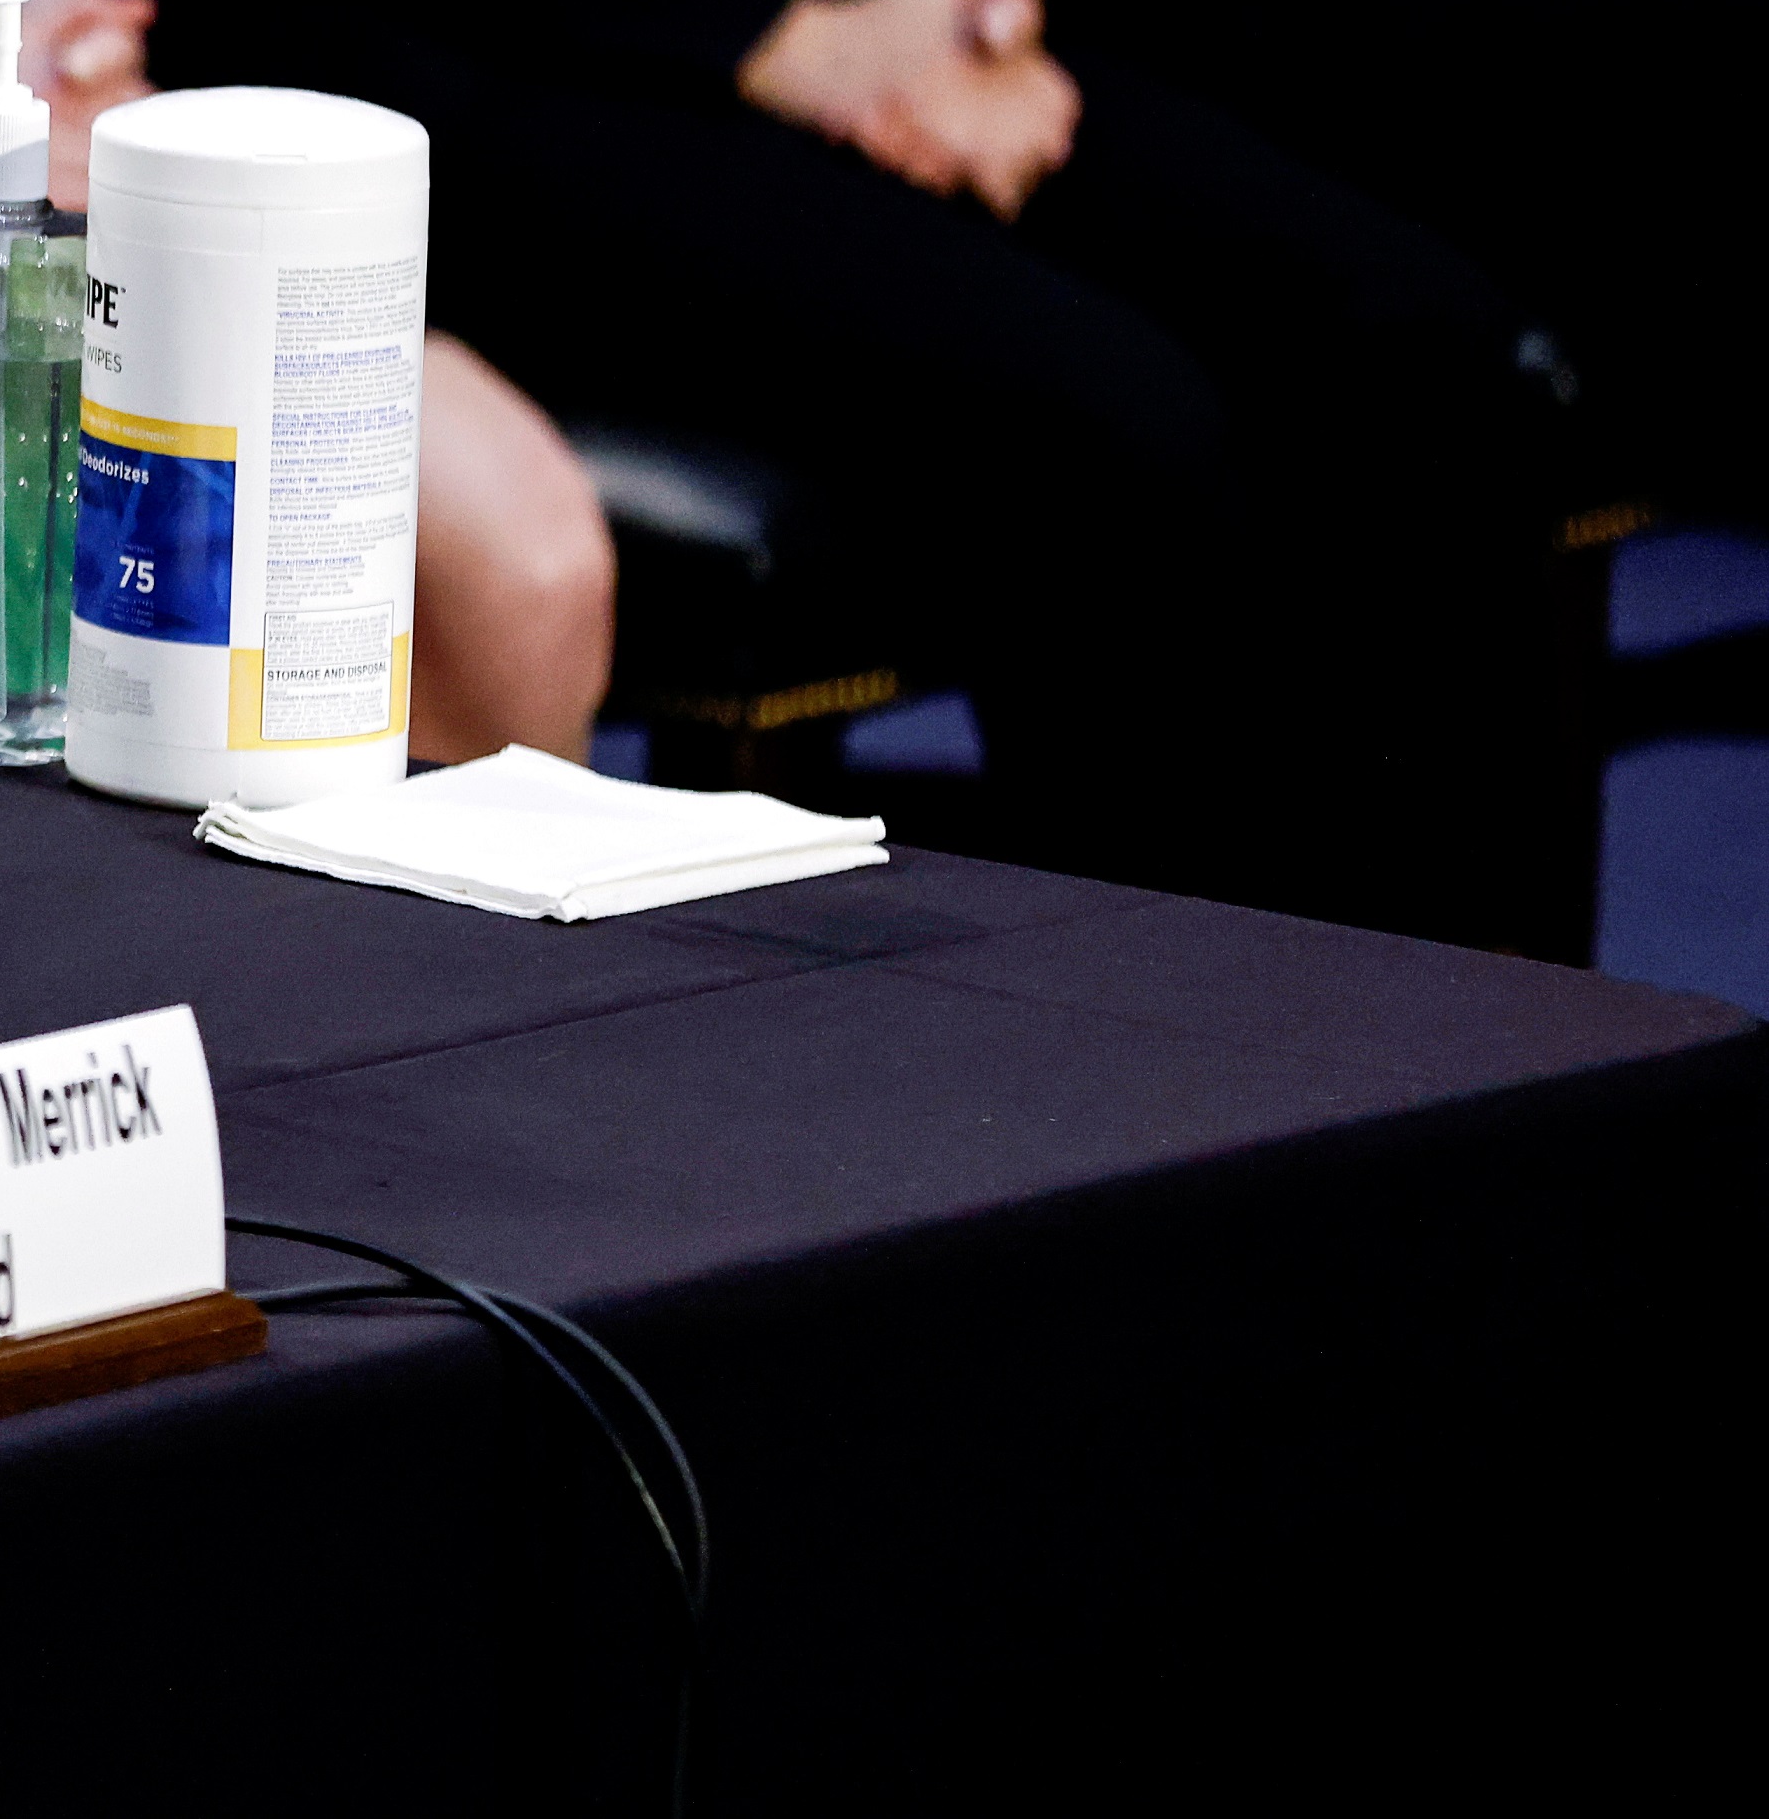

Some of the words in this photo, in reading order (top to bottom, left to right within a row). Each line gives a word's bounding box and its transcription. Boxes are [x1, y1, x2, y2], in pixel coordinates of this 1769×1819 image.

[85, 344, 122, 373] WIPES
[82, 449, 150, 485] Deodorizes
[119, 555, 155, 594] 75
[267, 669, 321, 682] STORAGE
[323, 667, 345, 680] AND
[347, 661, 387, 678] DISPOSAL
